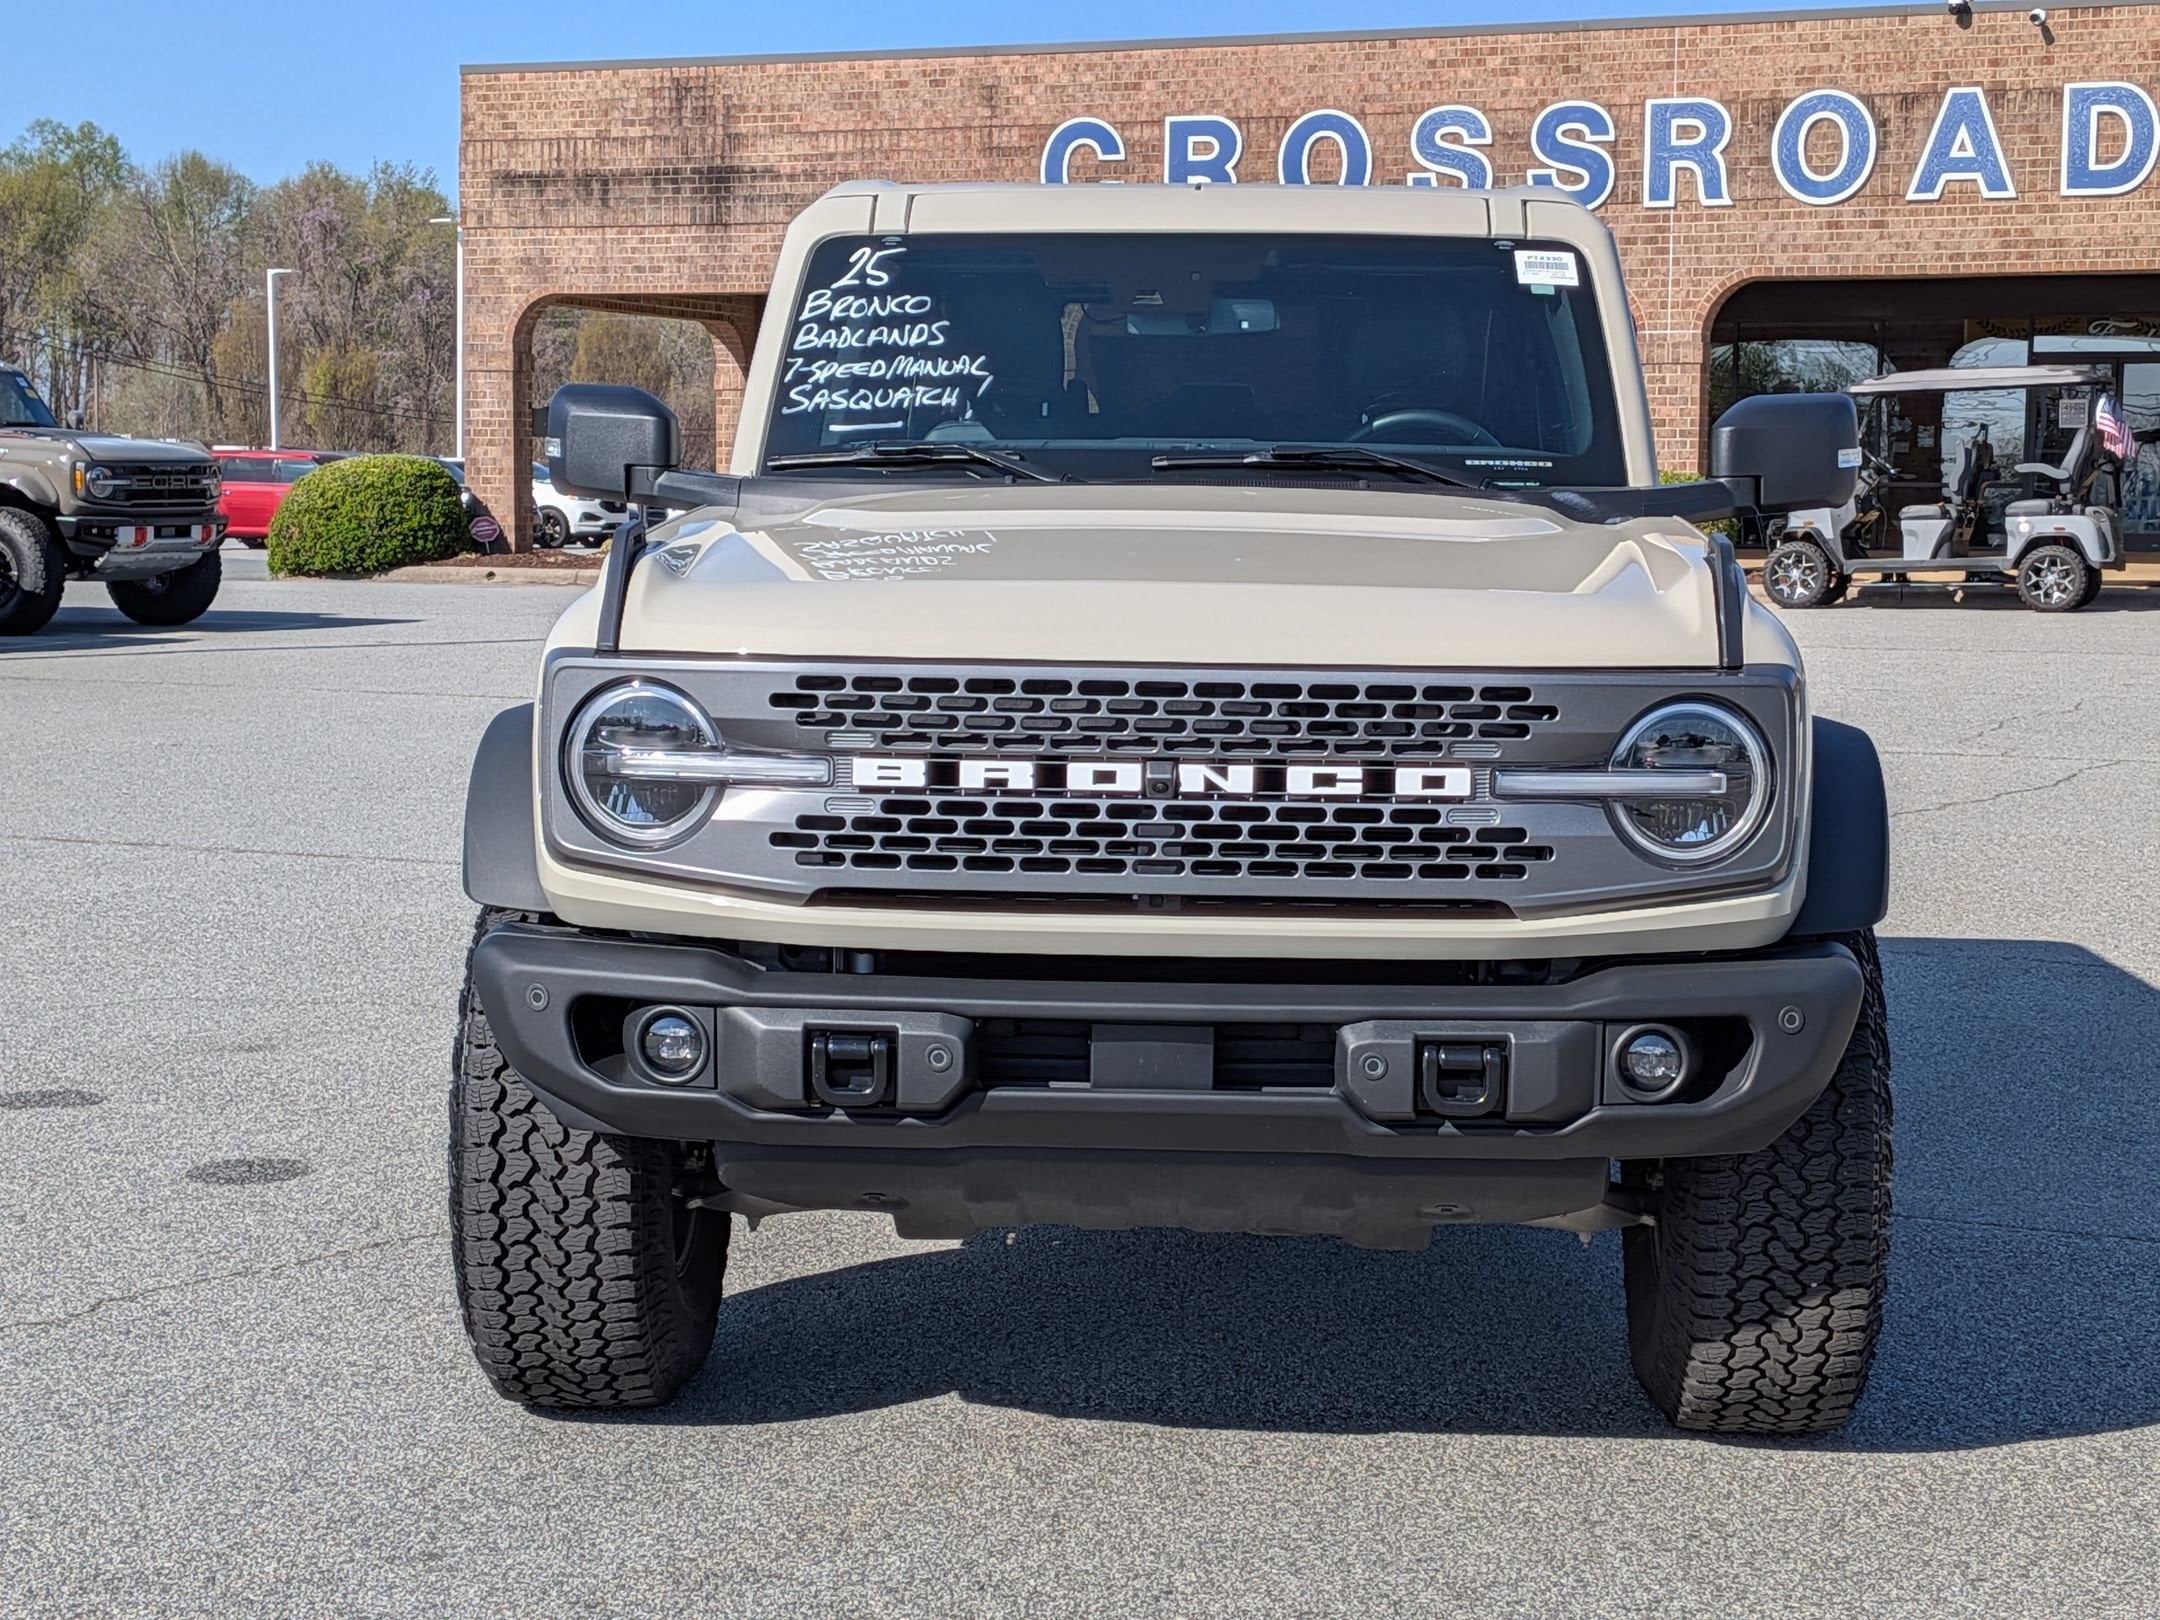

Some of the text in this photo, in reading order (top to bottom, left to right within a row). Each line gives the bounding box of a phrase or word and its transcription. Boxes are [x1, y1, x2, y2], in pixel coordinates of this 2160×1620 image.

[830, 247, 907, 289] 25
[798, 289, 932, 322] BRONCO
[793, 321, 950, 350] BADLANDS
[851, 756, 1471, 798] BRONCO
